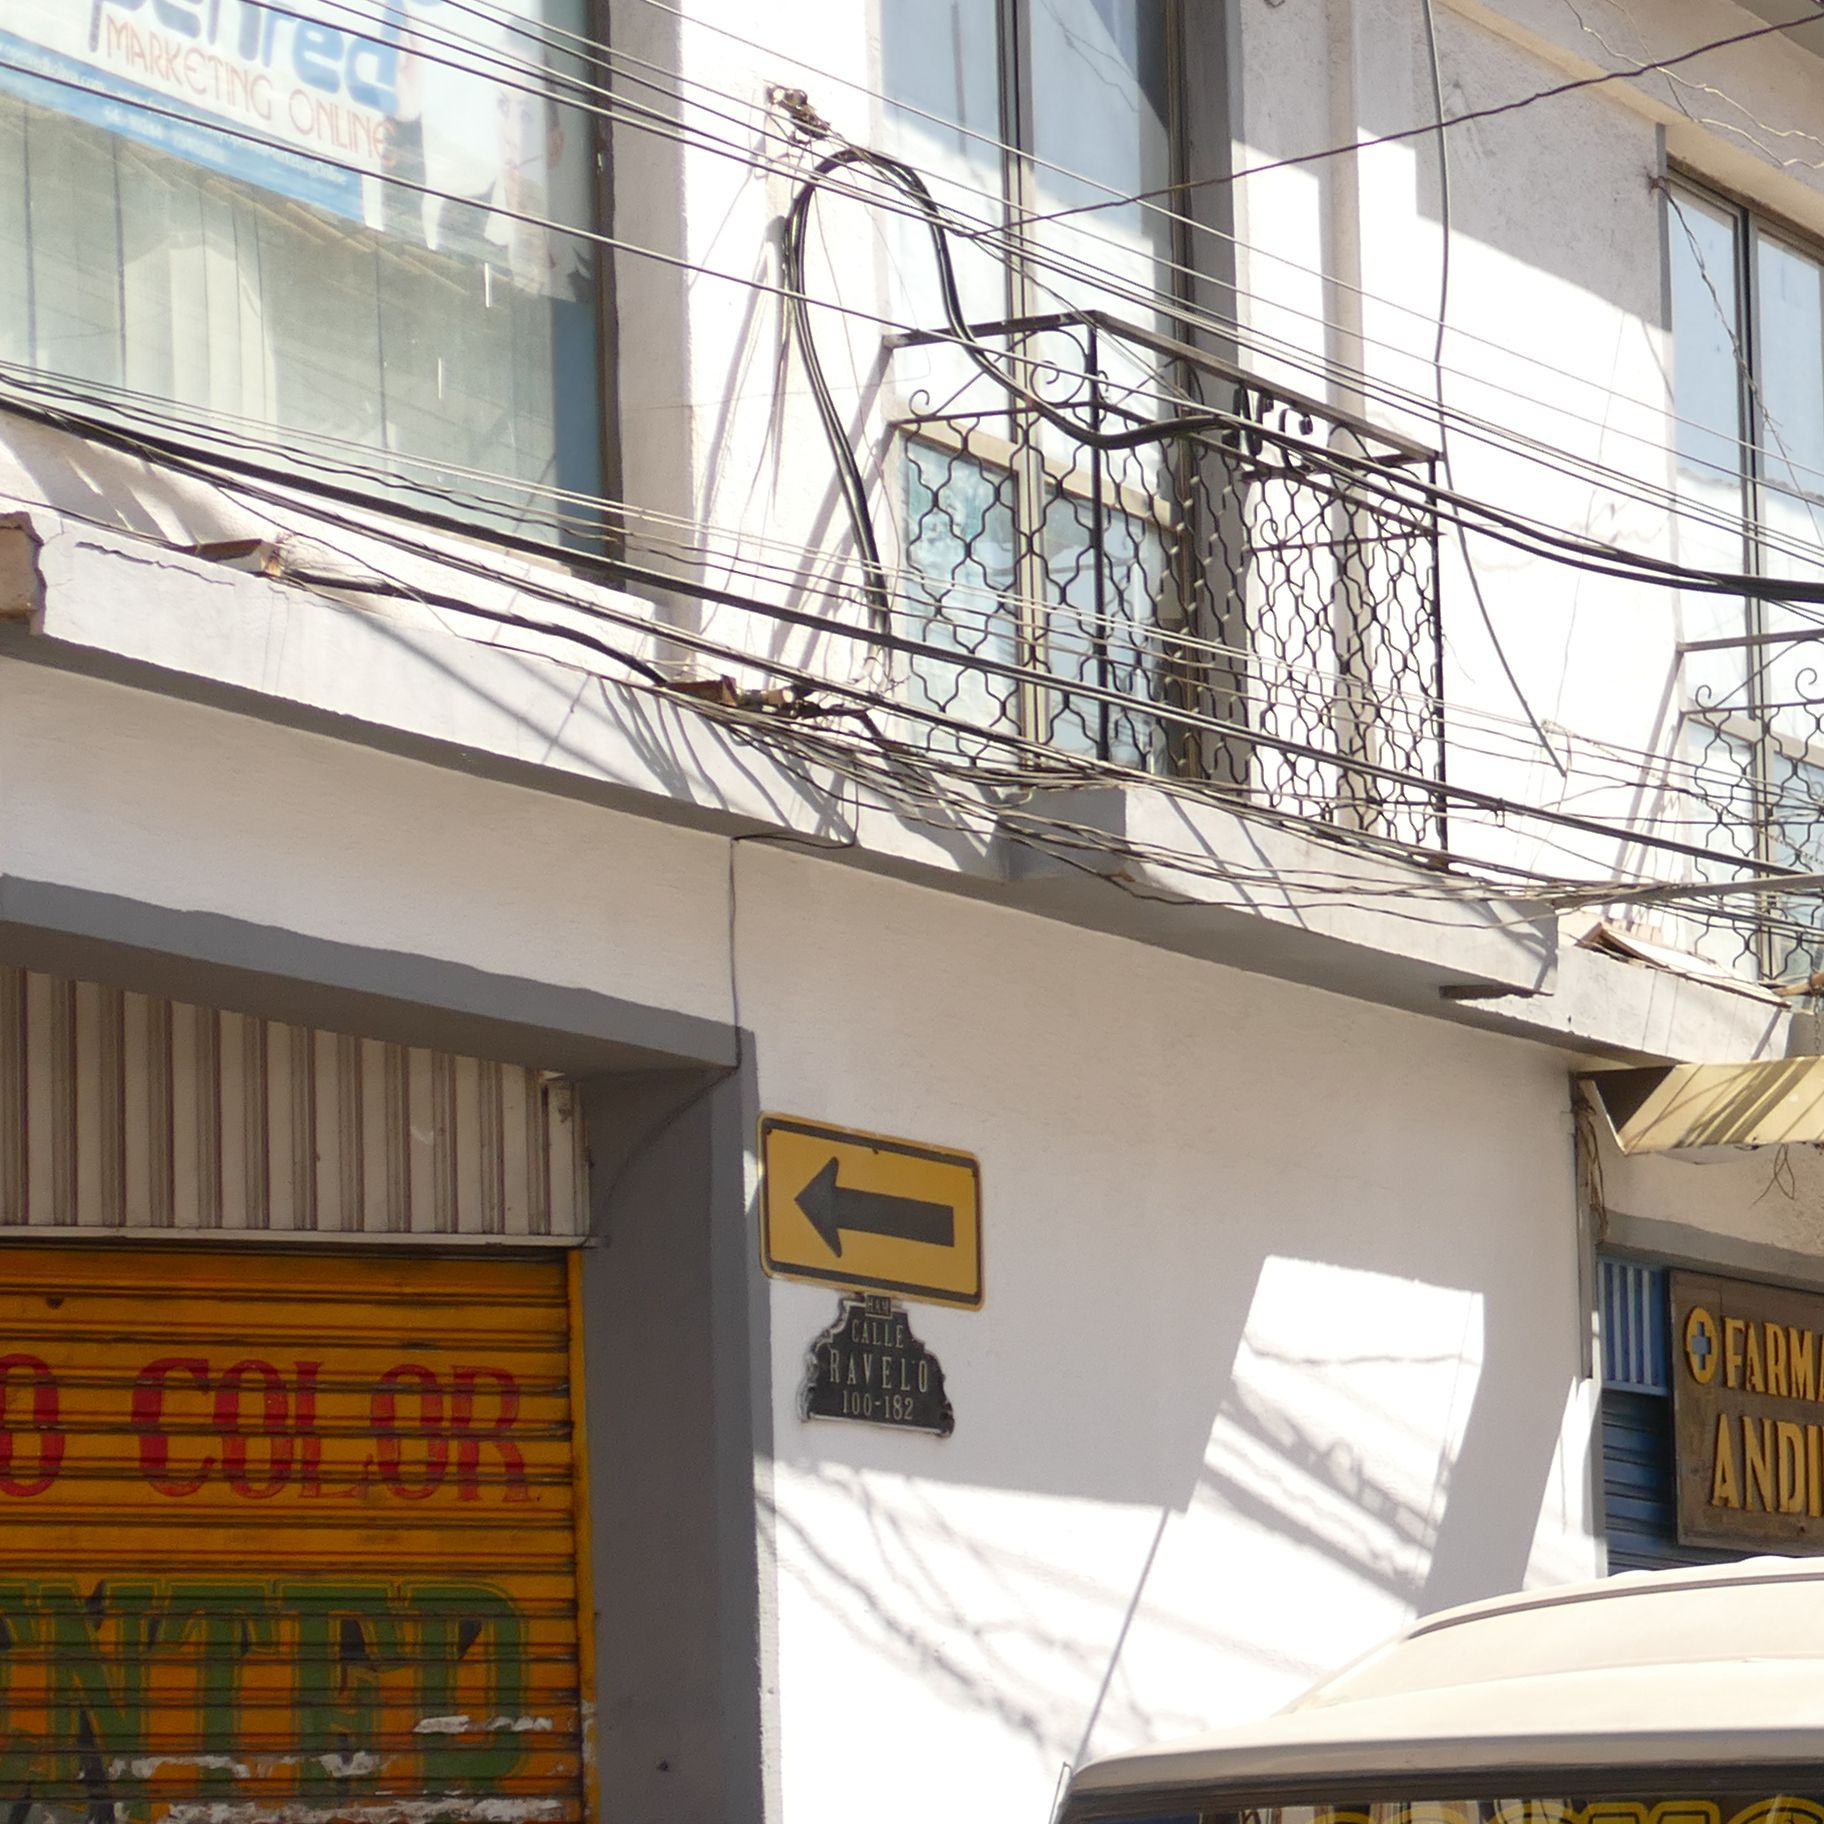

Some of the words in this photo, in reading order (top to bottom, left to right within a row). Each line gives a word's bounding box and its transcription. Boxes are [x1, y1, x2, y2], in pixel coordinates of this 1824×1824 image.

[105, 14, 273, 122] MARKETING
[288, 88, 398, 166] ONLINE
[851, 1318, 905, 1348] CALLE
[829, 1350, 929, 1393] RAVELO
[842, 1389, 914, 1421] 100-182
[131, 1357, 533, 1501] COLOR
